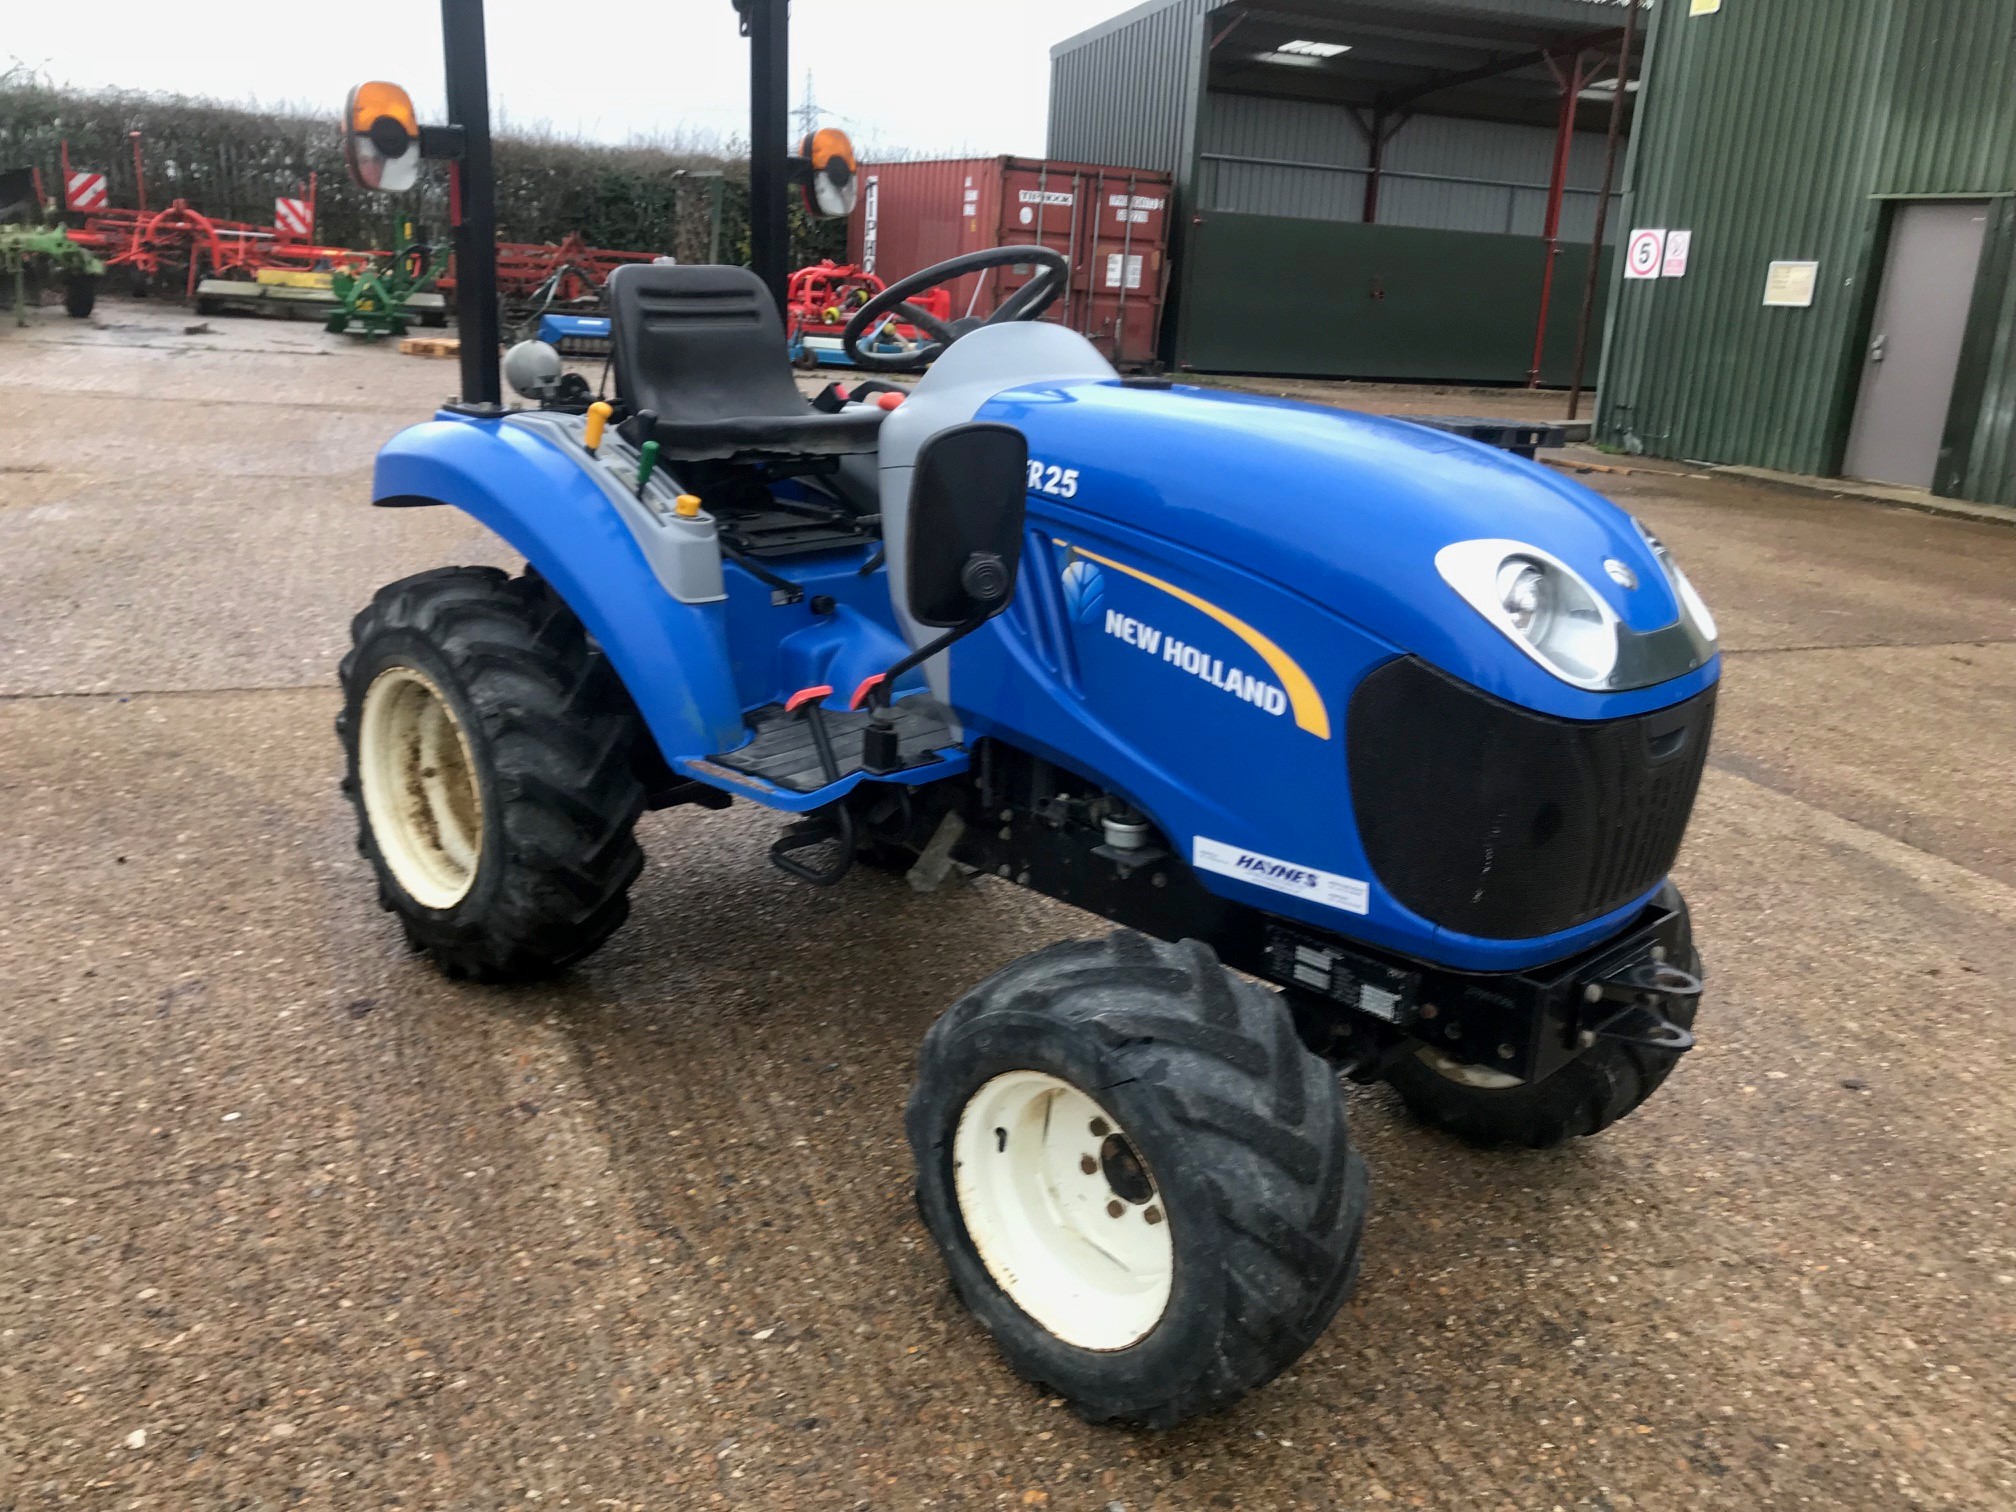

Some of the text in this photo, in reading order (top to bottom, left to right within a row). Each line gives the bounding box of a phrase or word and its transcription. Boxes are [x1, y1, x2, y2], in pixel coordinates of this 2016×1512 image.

[1639, 242, 1651, 264] 5
[1026, 459, 1079, 498] R25
[1104, 609, 1287, 716] NEW HOLLAND
[1235, 855, 1320, 888] HAYNES
